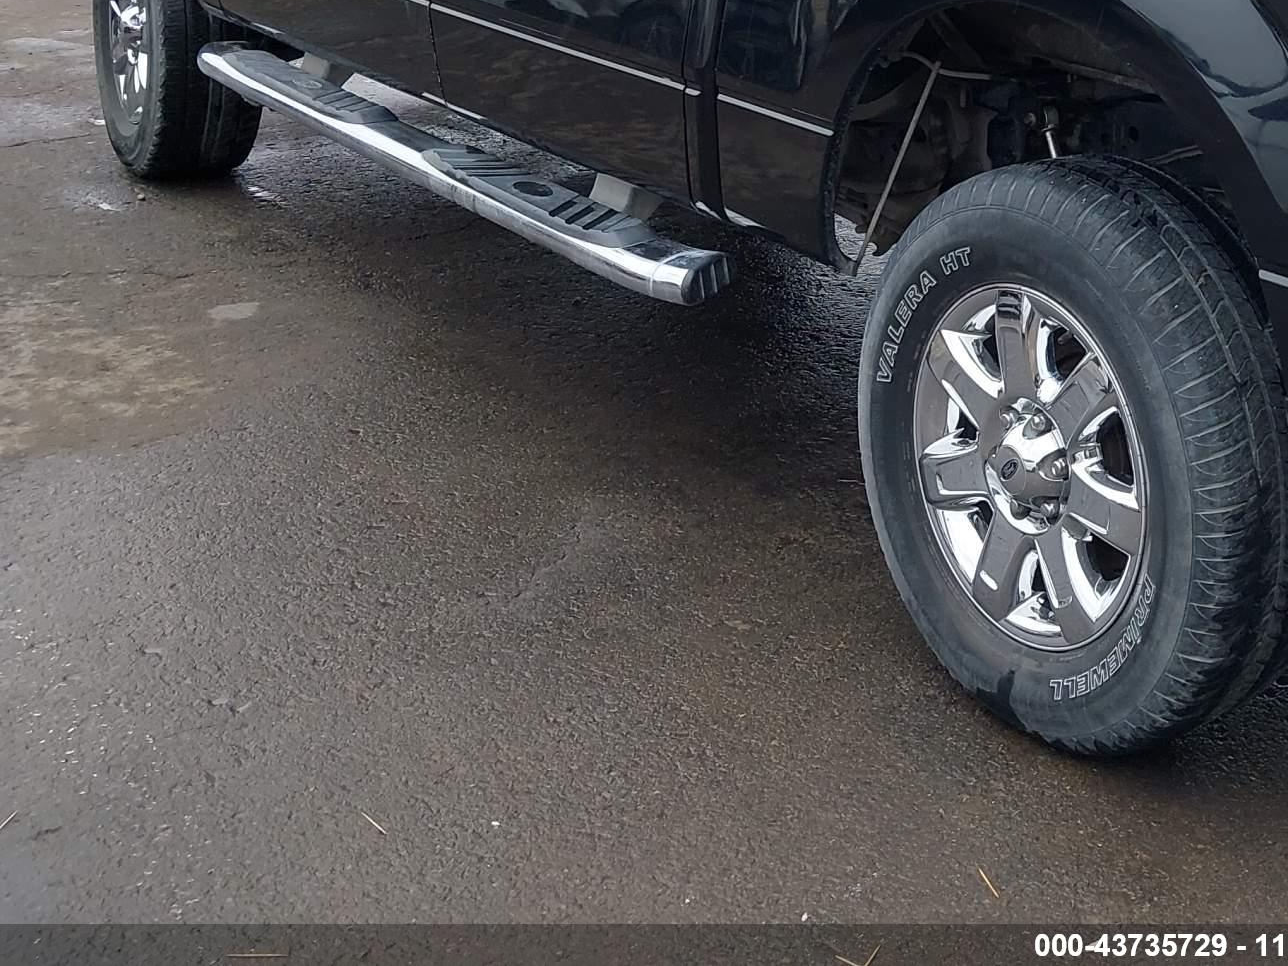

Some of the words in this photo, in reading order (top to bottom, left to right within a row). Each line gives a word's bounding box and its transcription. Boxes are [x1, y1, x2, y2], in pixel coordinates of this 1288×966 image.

[876, 269, 938, 384] VALERA
[939, 246, 971, 276] HT
[1049, 572, 1157, 701] PRIMEWELL
